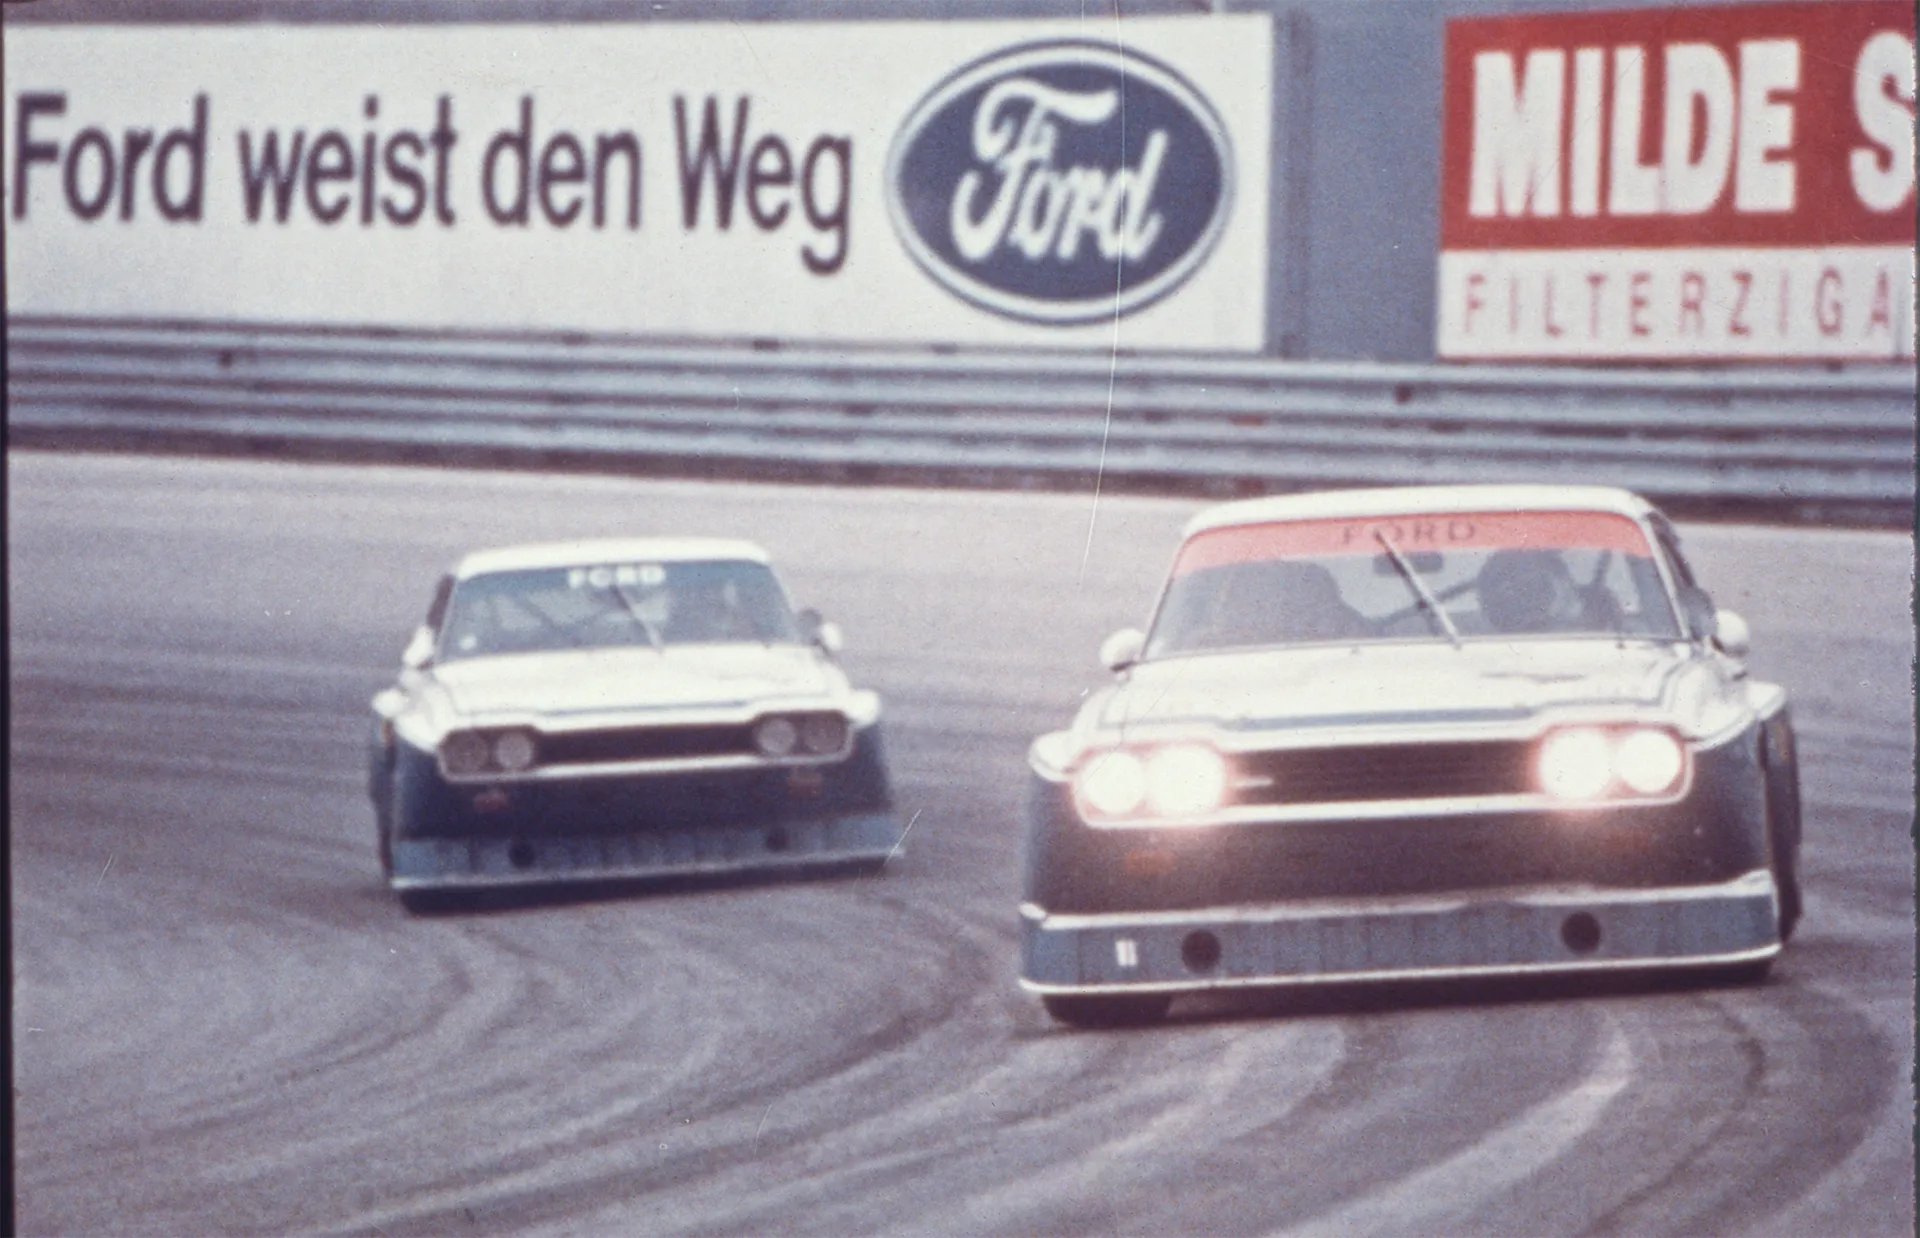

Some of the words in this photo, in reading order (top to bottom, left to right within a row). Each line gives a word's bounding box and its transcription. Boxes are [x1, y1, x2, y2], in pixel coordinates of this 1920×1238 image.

[13, 91, 209, 225] Ford
[238, 93, 456, 228] weist
[482, 94, 642, 230] den
[673, 94, 854, 276] Weg
[951, 78, 1169, 262] Ford
[1468, 38, 1799, 217] MILDE
[1465, 267, 1892, 338] FILTERZIGA
[1342, 519, 1476, 544] FORD
